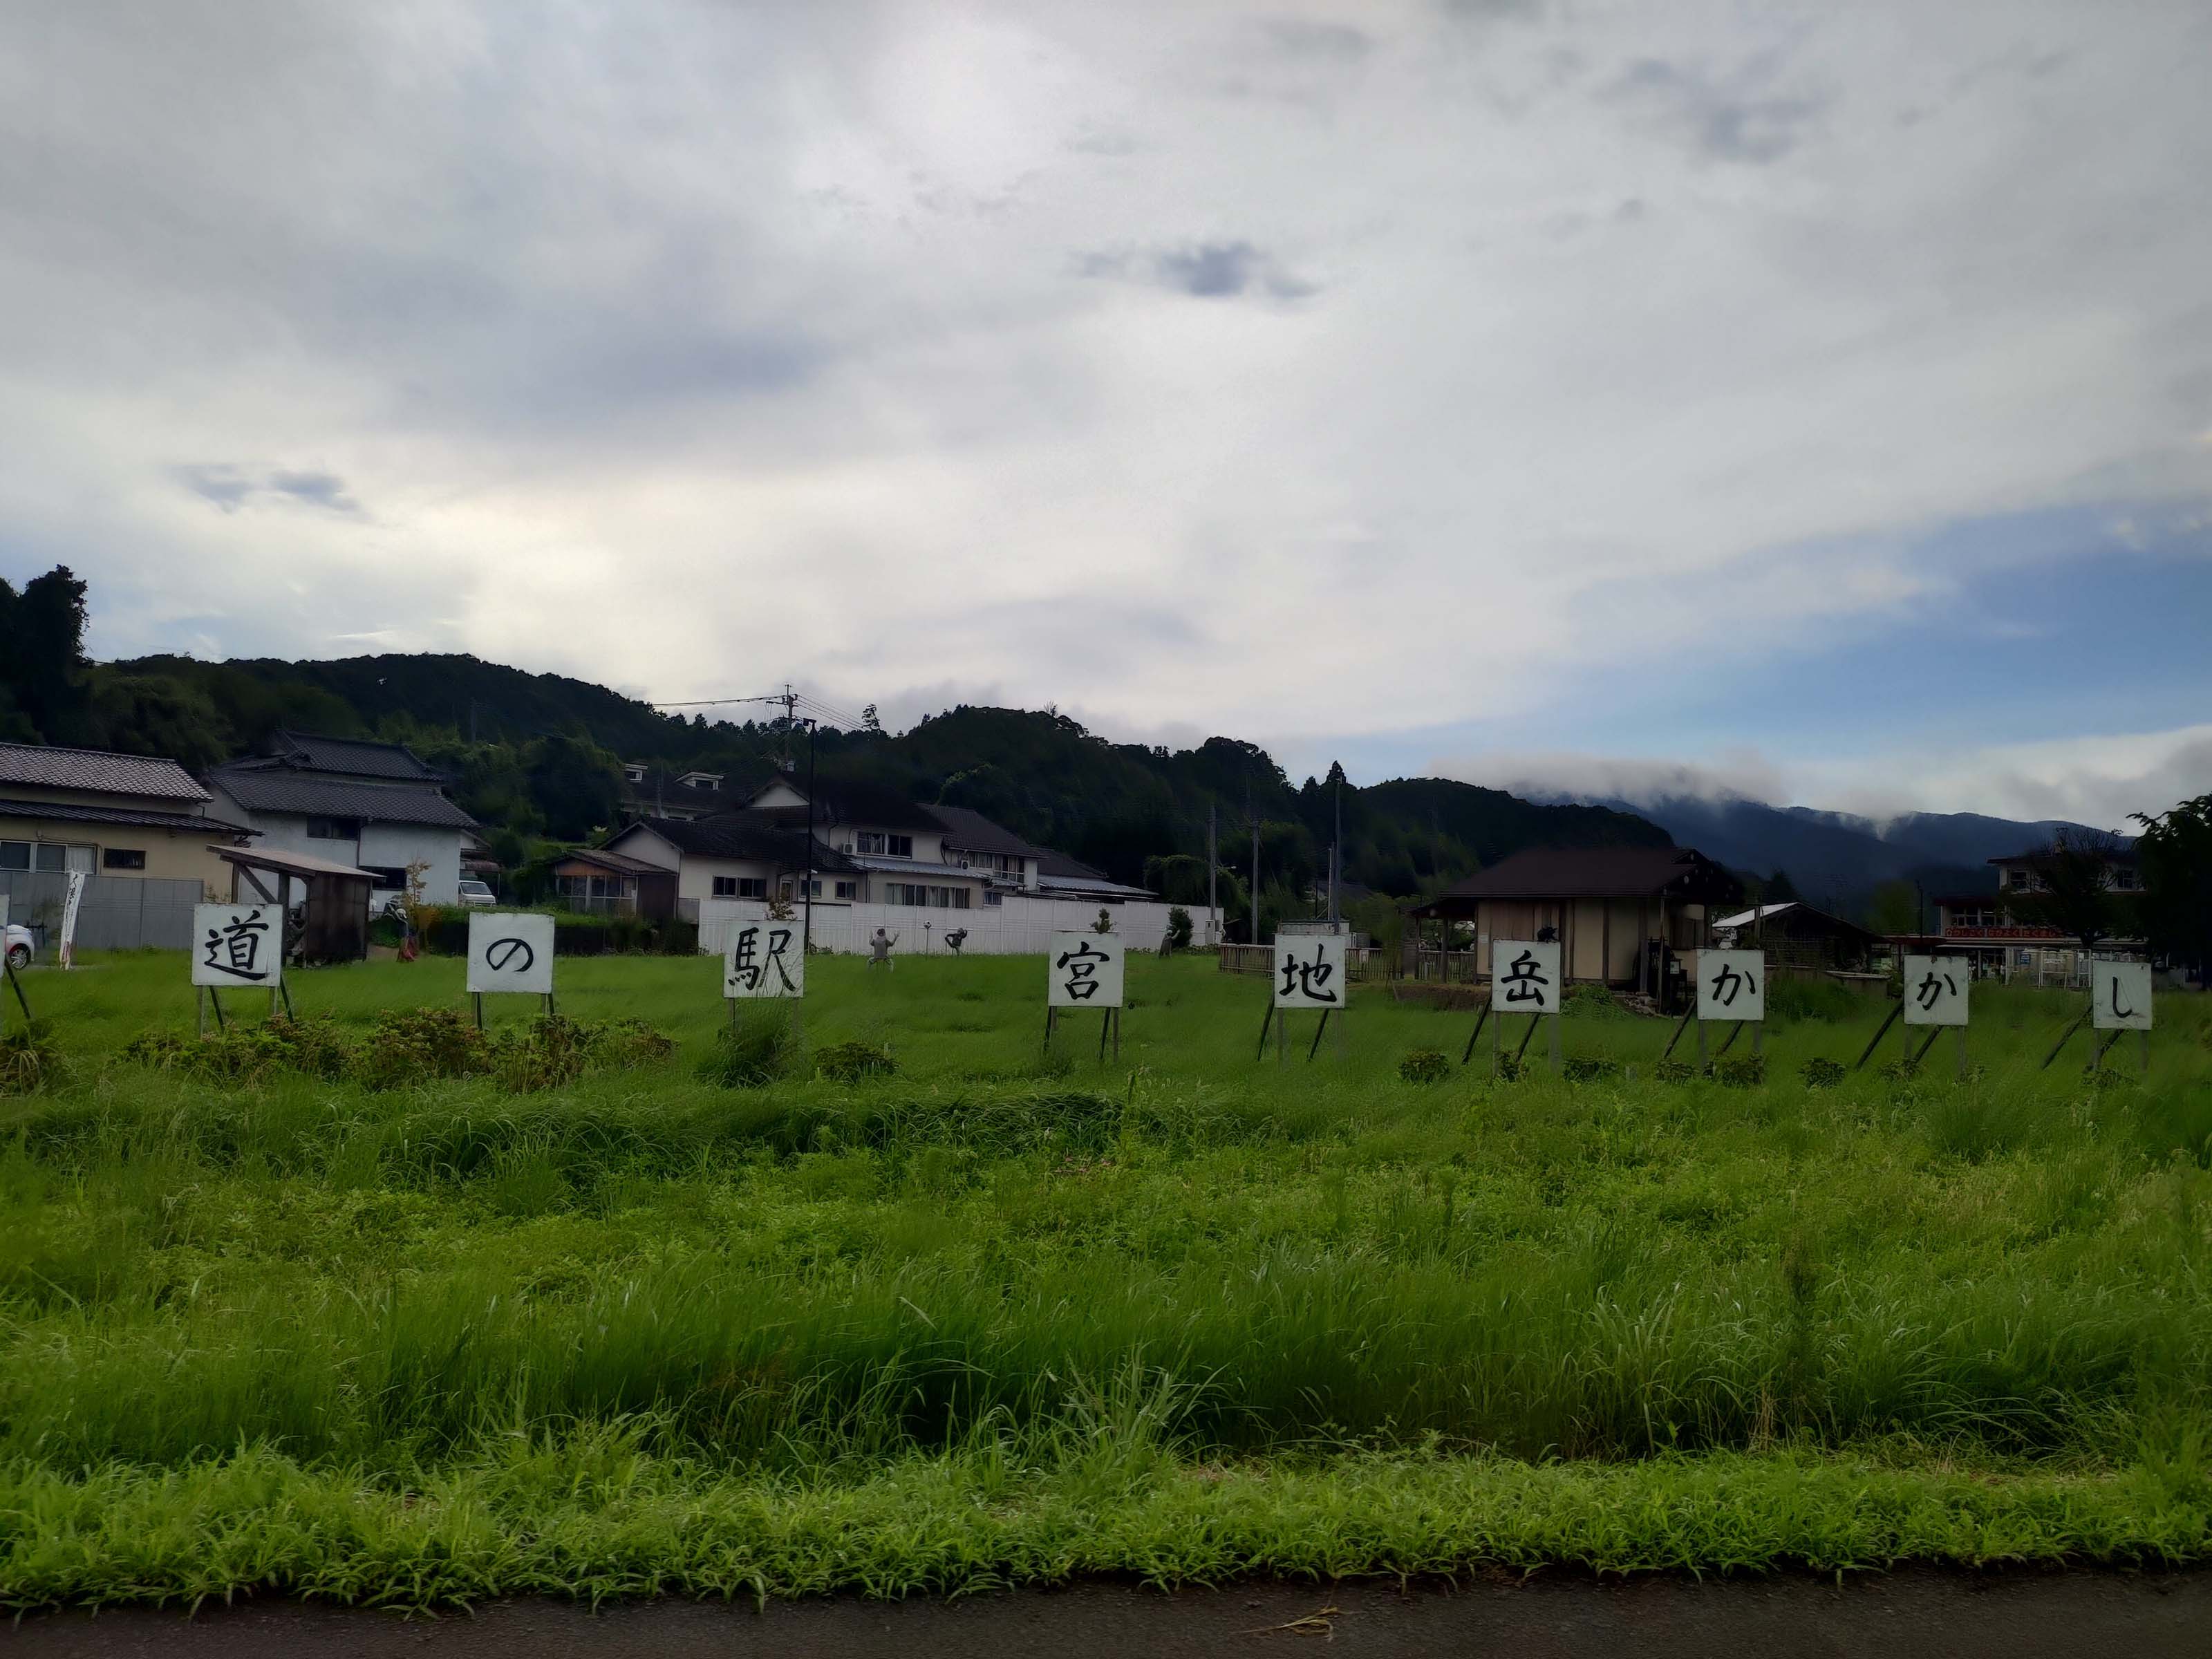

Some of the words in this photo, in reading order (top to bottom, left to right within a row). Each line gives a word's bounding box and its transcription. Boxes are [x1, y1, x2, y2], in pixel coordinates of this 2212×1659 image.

[203, 910, 270, 982] 道
[485, 939, 534, 973] の
[728, 927, 796, 992] 駅
[1056, 941, 1110, 1000] 宮
[1279, 944, 1338, 1003] 地
[1501, 950, 1549, 1006] 岳
[1711, 964, 1756, 1007] か
[1916, 972, 1957, 1011] か
[2112, 977, 2133, 1019] し
